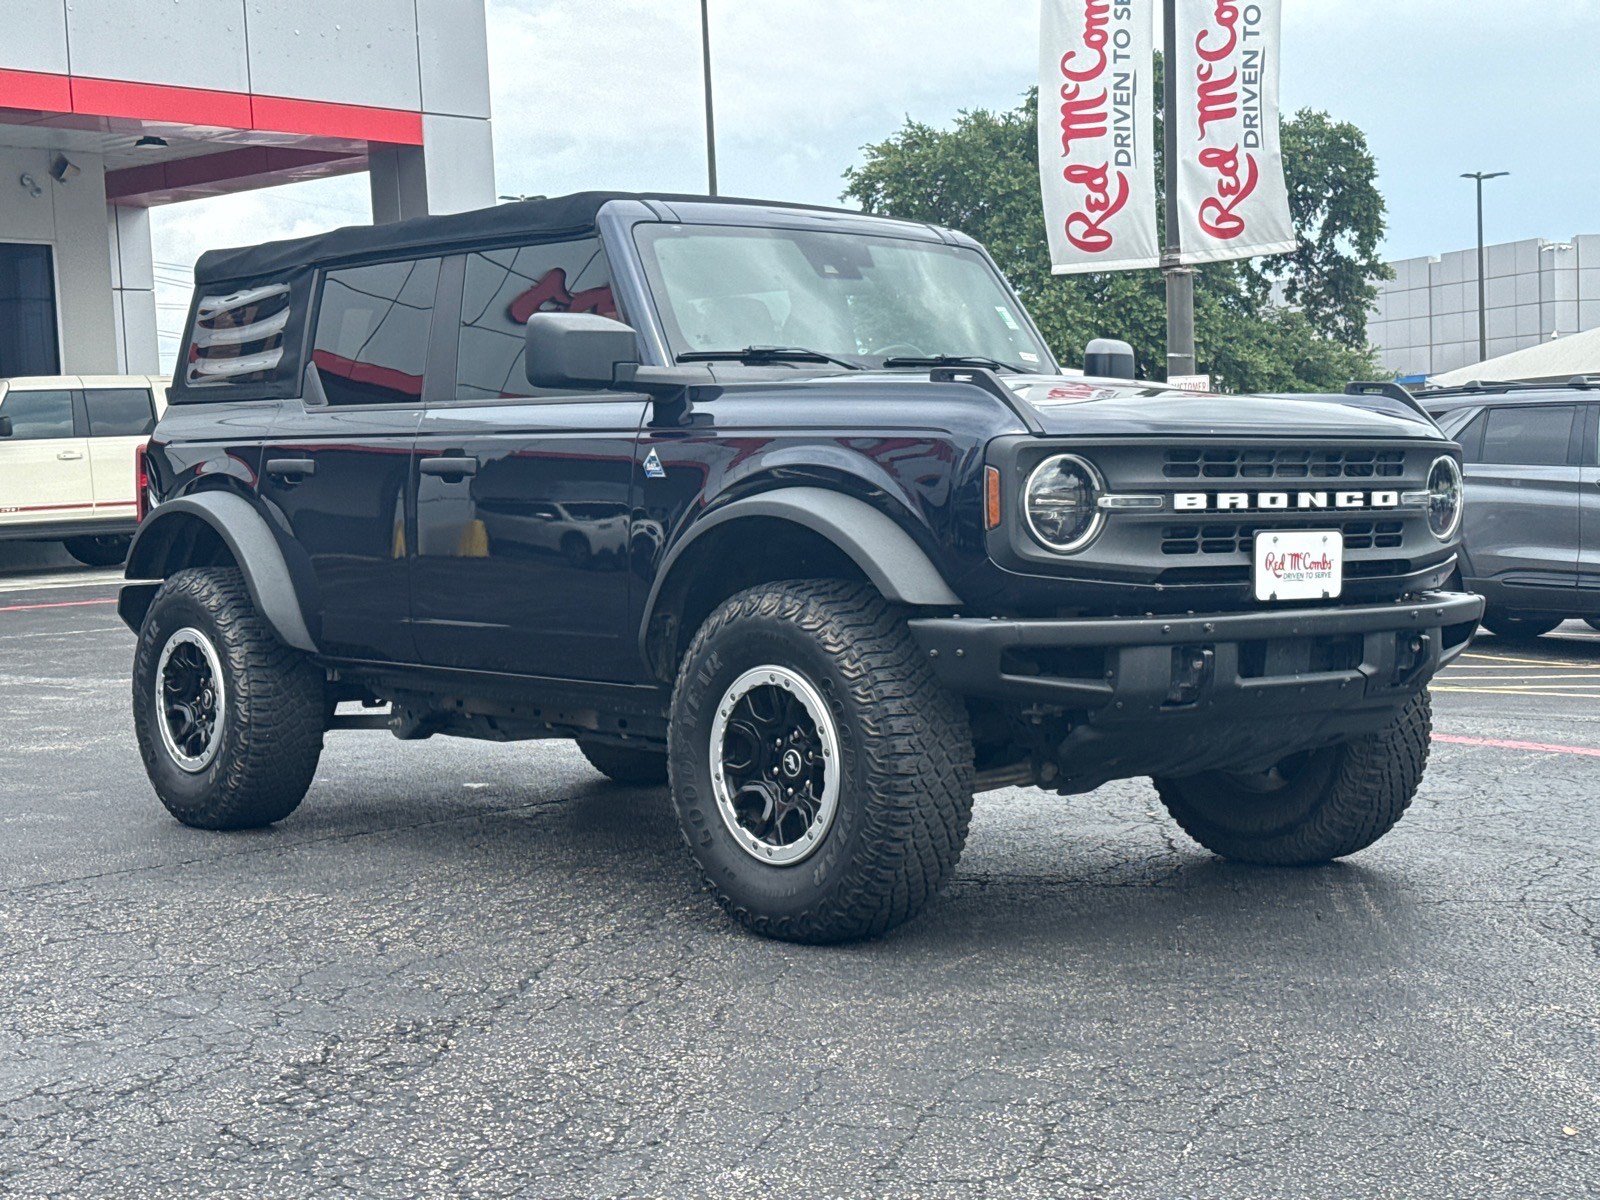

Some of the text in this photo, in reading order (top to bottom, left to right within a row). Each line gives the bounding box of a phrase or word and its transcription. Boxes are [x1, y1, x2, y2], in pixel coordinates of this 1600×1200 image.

[1113, 29, 1131, 64] TO
[1242, 5, 1261, 149] DRIVEN TO
[1113, 72, 1131, 166] DRIVEN
[1195, 0, 1258, 240] Red McCo
[1063, 161, 1130, 252] Red
[1174, 491, 1398, 509] BRONCO
[1265, 552, 1332, 578] Red McCombs
